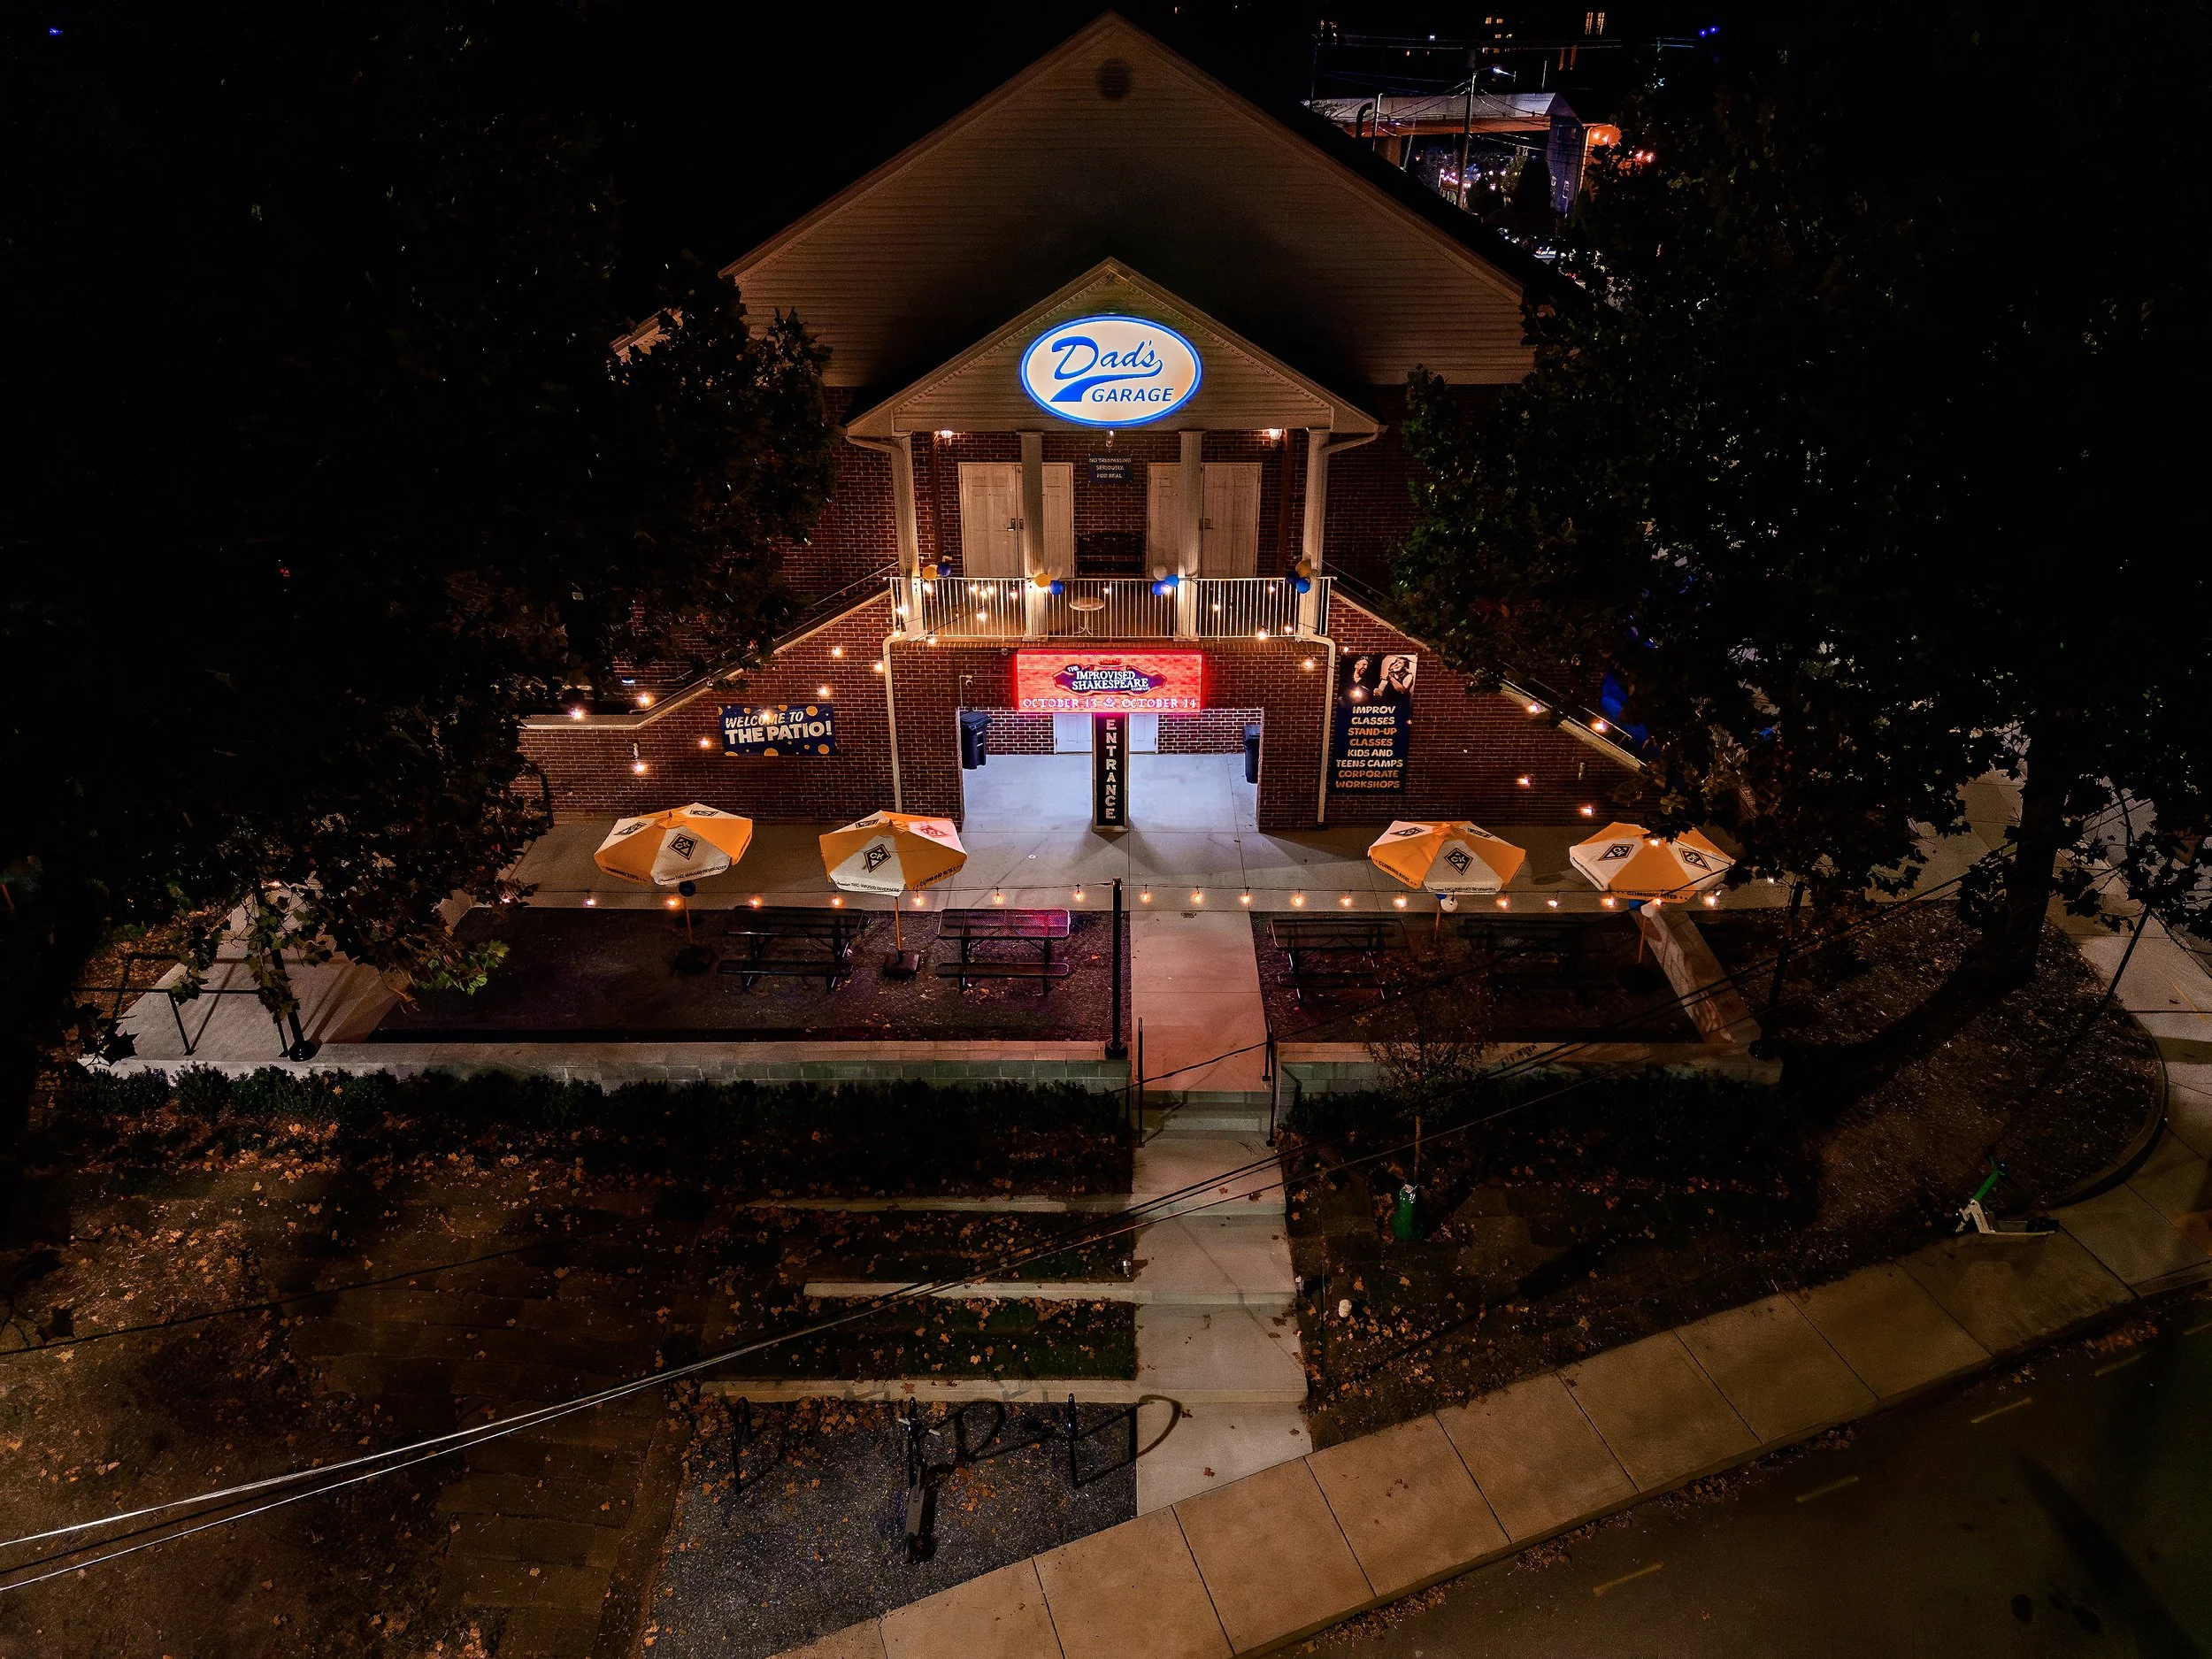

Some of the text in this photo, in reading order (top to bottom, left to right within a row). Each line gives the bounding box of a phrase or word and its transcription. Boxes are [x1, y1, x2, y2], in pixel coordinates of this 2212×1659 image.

[1051, 335, 1163, 380] Dad's
[1091, 388, 1174, 403] GARAGE
[1075, 671, 1135, 680] IMPROVISED
[1071, 678, 1149, 690] SHAKESPEARE
[1023, 698, 1079, 708] OCTOBER
[1085, 698, 1097, 708] 13
[1122, 698, 1178, 708] OCTOBER
[1183, 698, 1196, 708] 14
[726, 710, 804, 728] WELCOME TO
[725, 720, 832, 744] THE PATIO!
[1348, 727, 1397, 736] STAND-UP
[1349, 738, 1394, 747] CLASSES
[1347, 749, 1394, 757] KIDS AND
[1104, 718, 1118, 819] ENTRANCE
[1336, 759, 1403, 768] TEENS CAMPS
